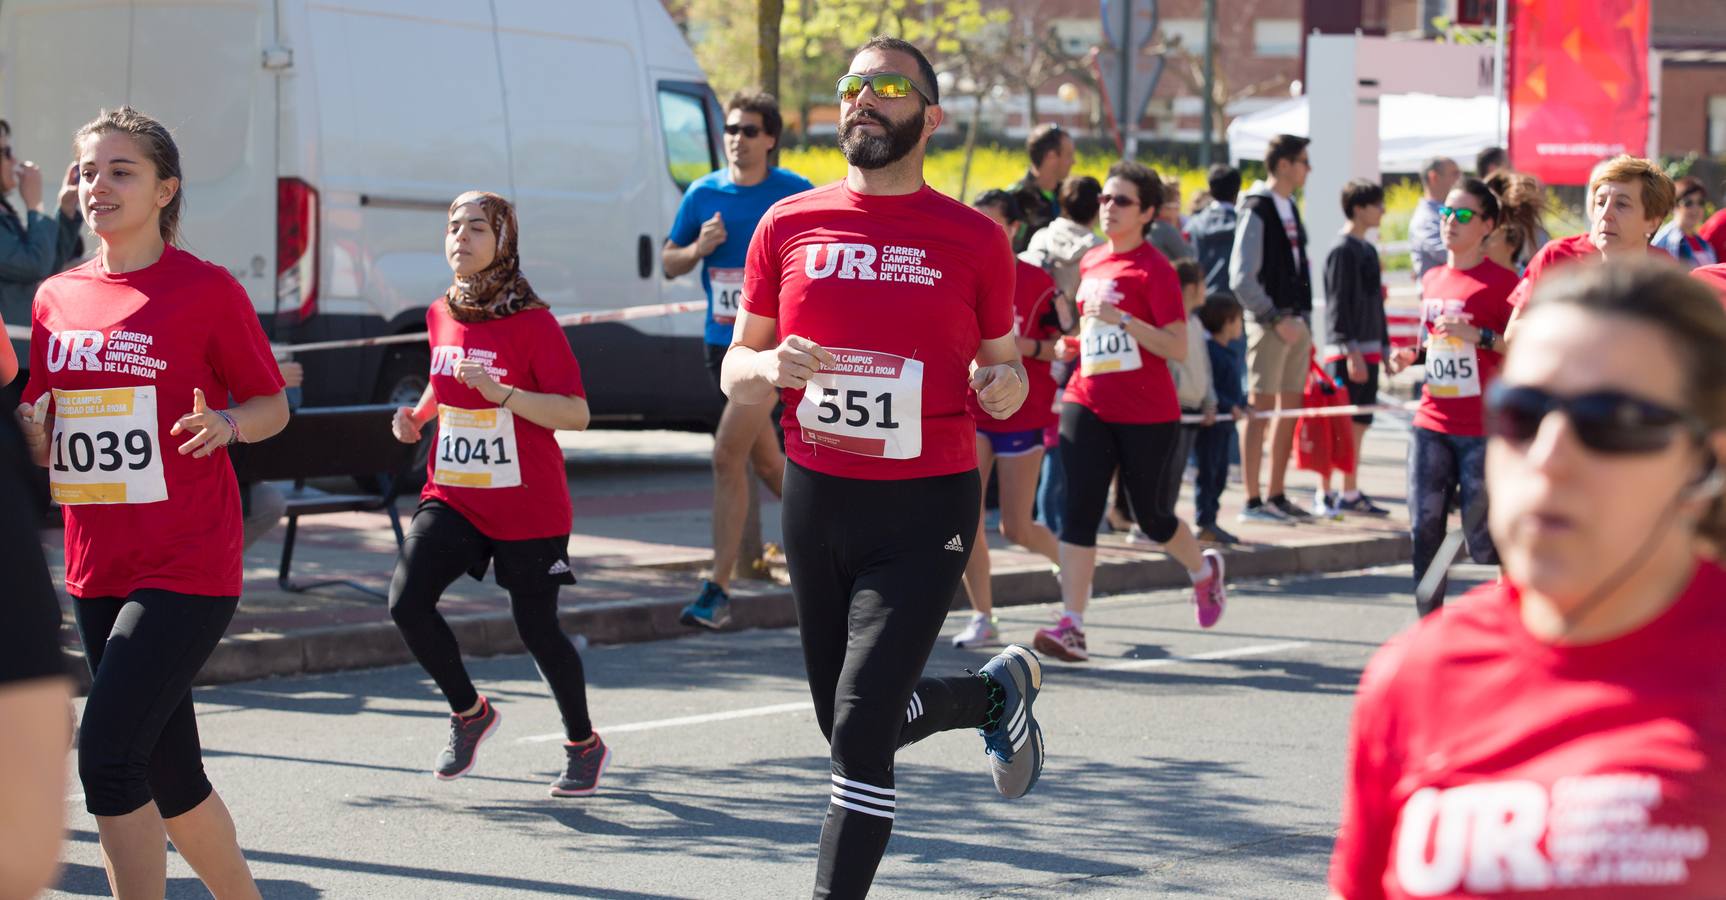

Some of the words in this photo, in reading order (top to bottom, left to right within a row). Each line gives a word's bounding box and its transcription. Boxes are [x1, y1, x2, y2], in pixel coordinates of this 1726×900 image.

[881, 254, 922, 266] CAMPUS
[883, 245, 926, 258] CARRERA
[804, 243, 878, 280] UR
[880, 272, 893, 281] DE
[894, 273, 907, 282] LA
[908, 274, 935, 286] RIOJA
[881, 263, 943, 280] UNIVERSIDAD
[720, 289, 742, 310] 40
[107, 340, 147, 354] CAMPUS
[109, 330, 153, 345] CARRERA
[1086, 332, 1132, 357] 1101
[47, 330, 104, 373] UR
[105, 350, 167, 371] UNIVERSIDAD
[431, 345, 465, 376] UR
[468, 348, 497, 360] CARRERA
[842, 354, 873, 364] CAMPUS
[104, 361, 116, 372] DE
[117, 363, 129, 374] LA
[130, 365, 157, 379] RIOJA
[853, 365, 864, 373] DE
[864, 365, 874, 374] LA
[875, 366, 896, 375] RIOJA
[1428, 357, 1473, 379] 045
[817, 388, 899, 429] 551
[53, 429, 152, 473] 1039
[441, 435, 512, 465] 1041
